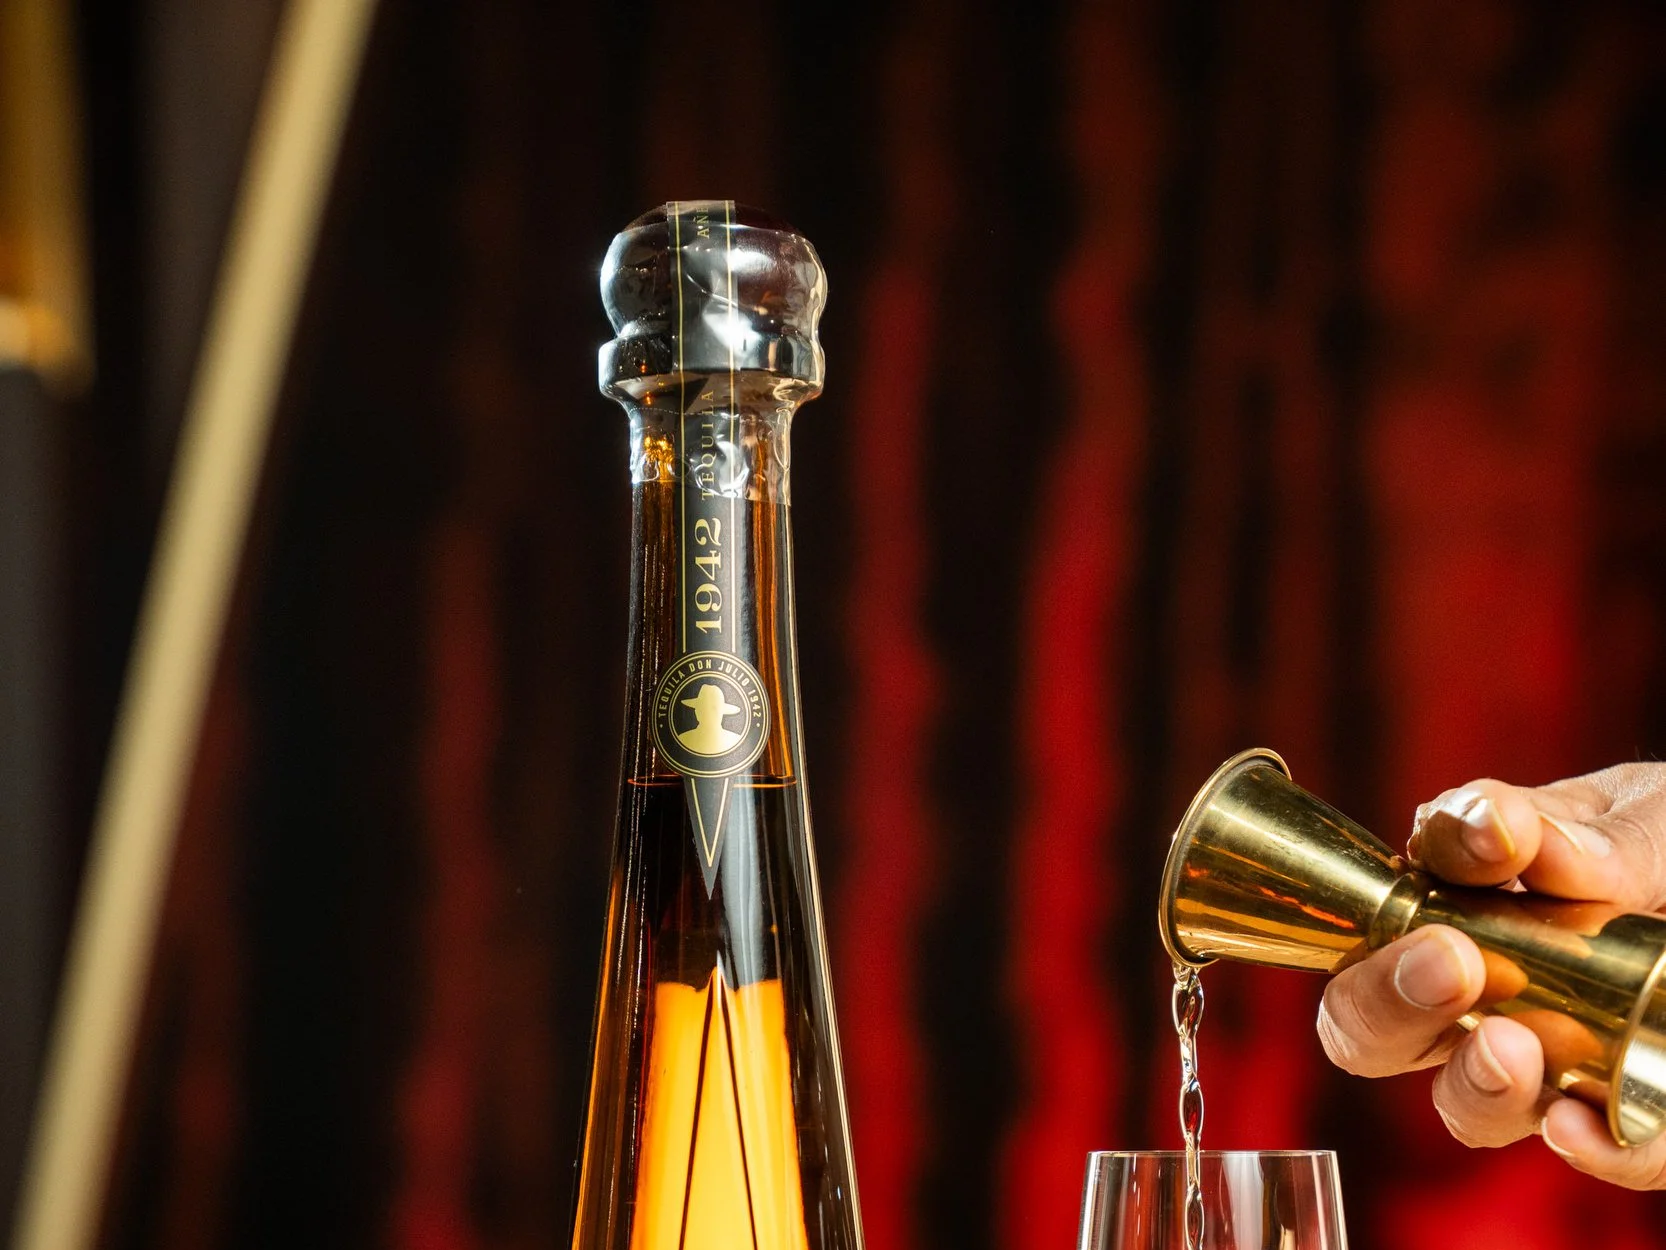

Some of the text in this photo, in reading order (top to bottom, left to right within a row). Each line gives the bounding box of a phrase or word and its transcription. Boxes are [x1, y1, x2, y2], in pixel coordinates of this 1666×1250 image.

[701, 391, 715, 501] TEQUILA
[694, 517, 722, 634] 1942
[658, 659, 762, 718] TEQUILA DON JULIO 1942
